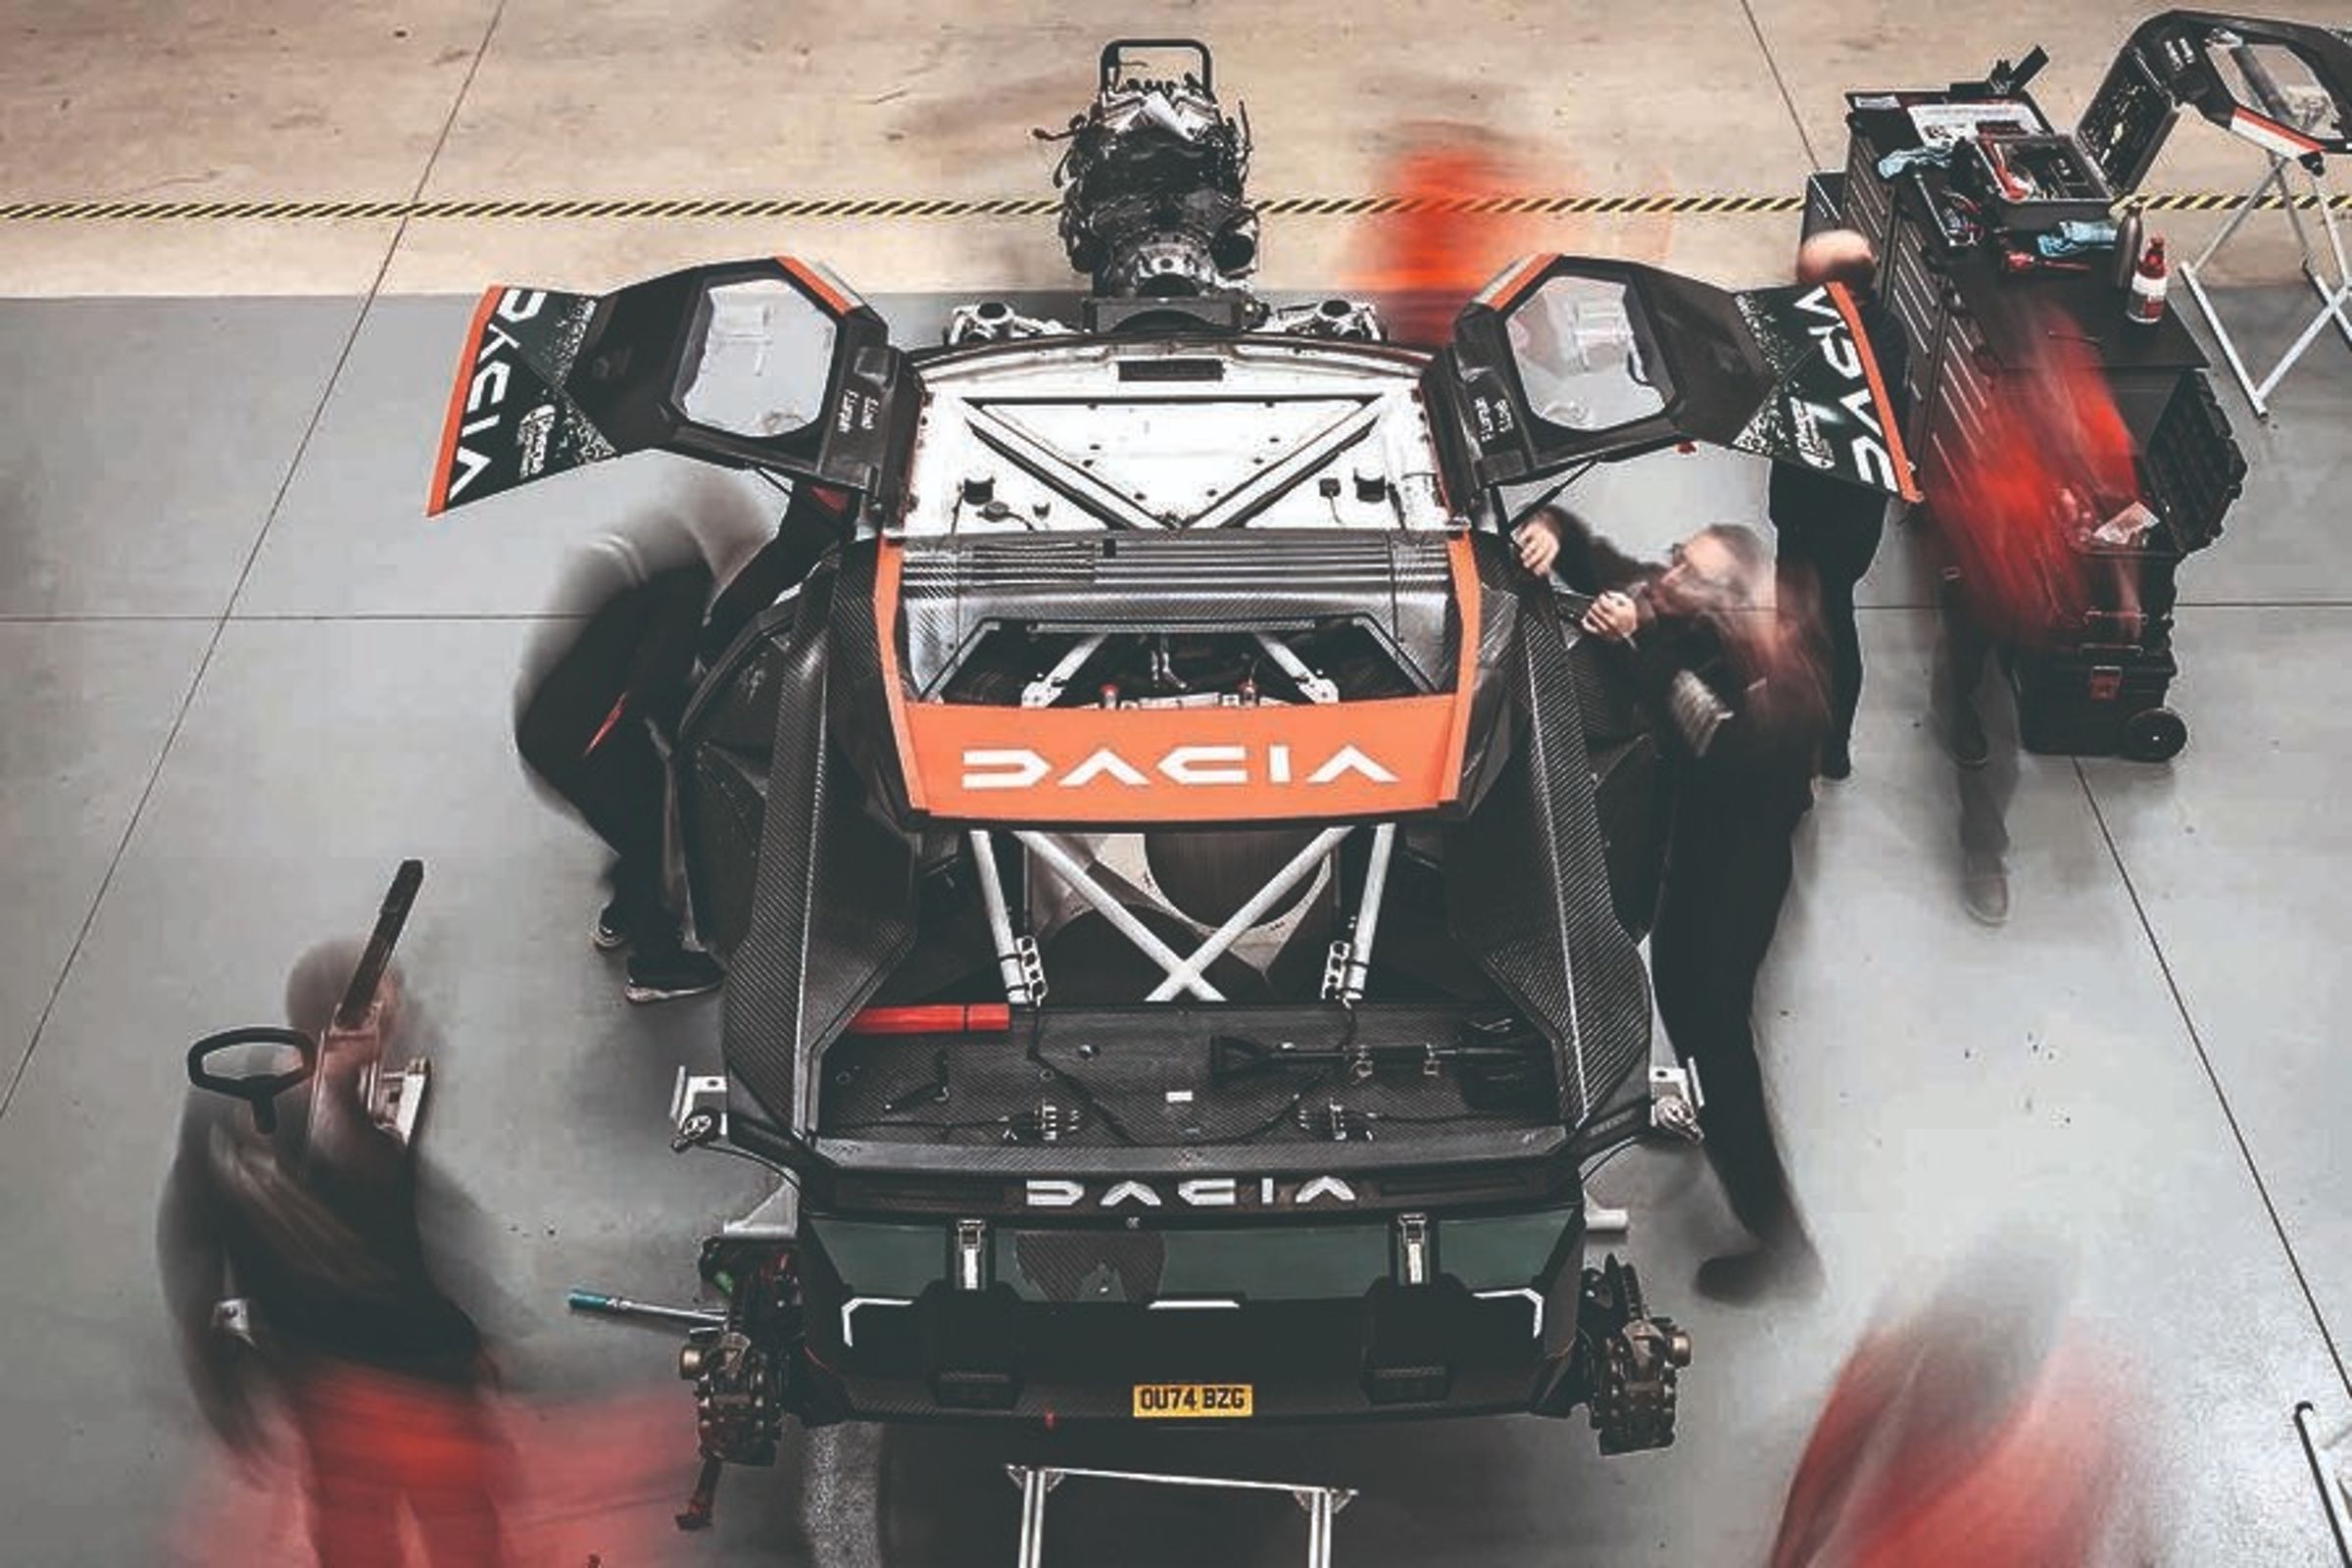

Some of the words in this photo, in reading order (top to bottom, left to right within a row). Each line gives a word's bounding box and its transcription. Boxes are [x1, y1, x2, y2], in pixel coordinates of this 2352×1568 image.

[449, 288, 548, 502] DACIA
[1792, 285, 1899, 493] DACIA
[961, 745, 1400, 789] DACIA
[1026, 1176, 1355, 1206] DACIA
[1141, 1387, 1198, 1410] OU74
[1201, 1387, 1246, 1409] BZG
